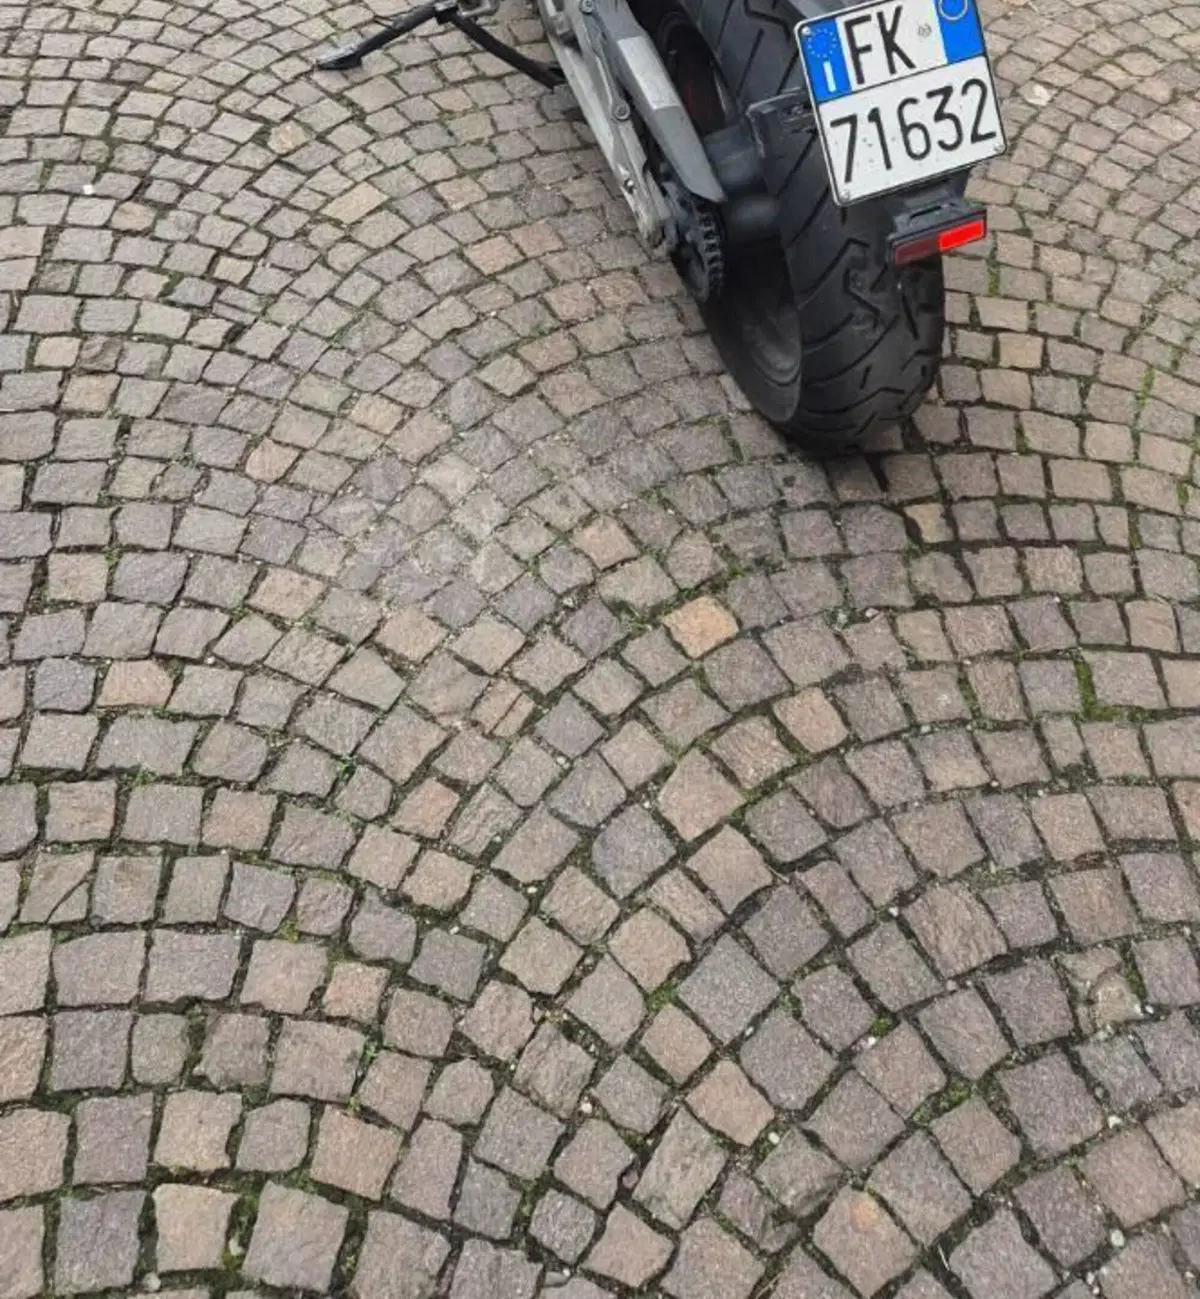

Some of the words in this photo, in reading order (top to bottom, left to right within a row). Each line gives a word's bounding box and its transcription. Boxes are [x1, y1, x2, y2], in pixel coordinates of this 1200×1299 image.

[823, 61, 837, 93] I
[843, 5, 916, 85] FK
[829, 78, 997, 184] 71632
